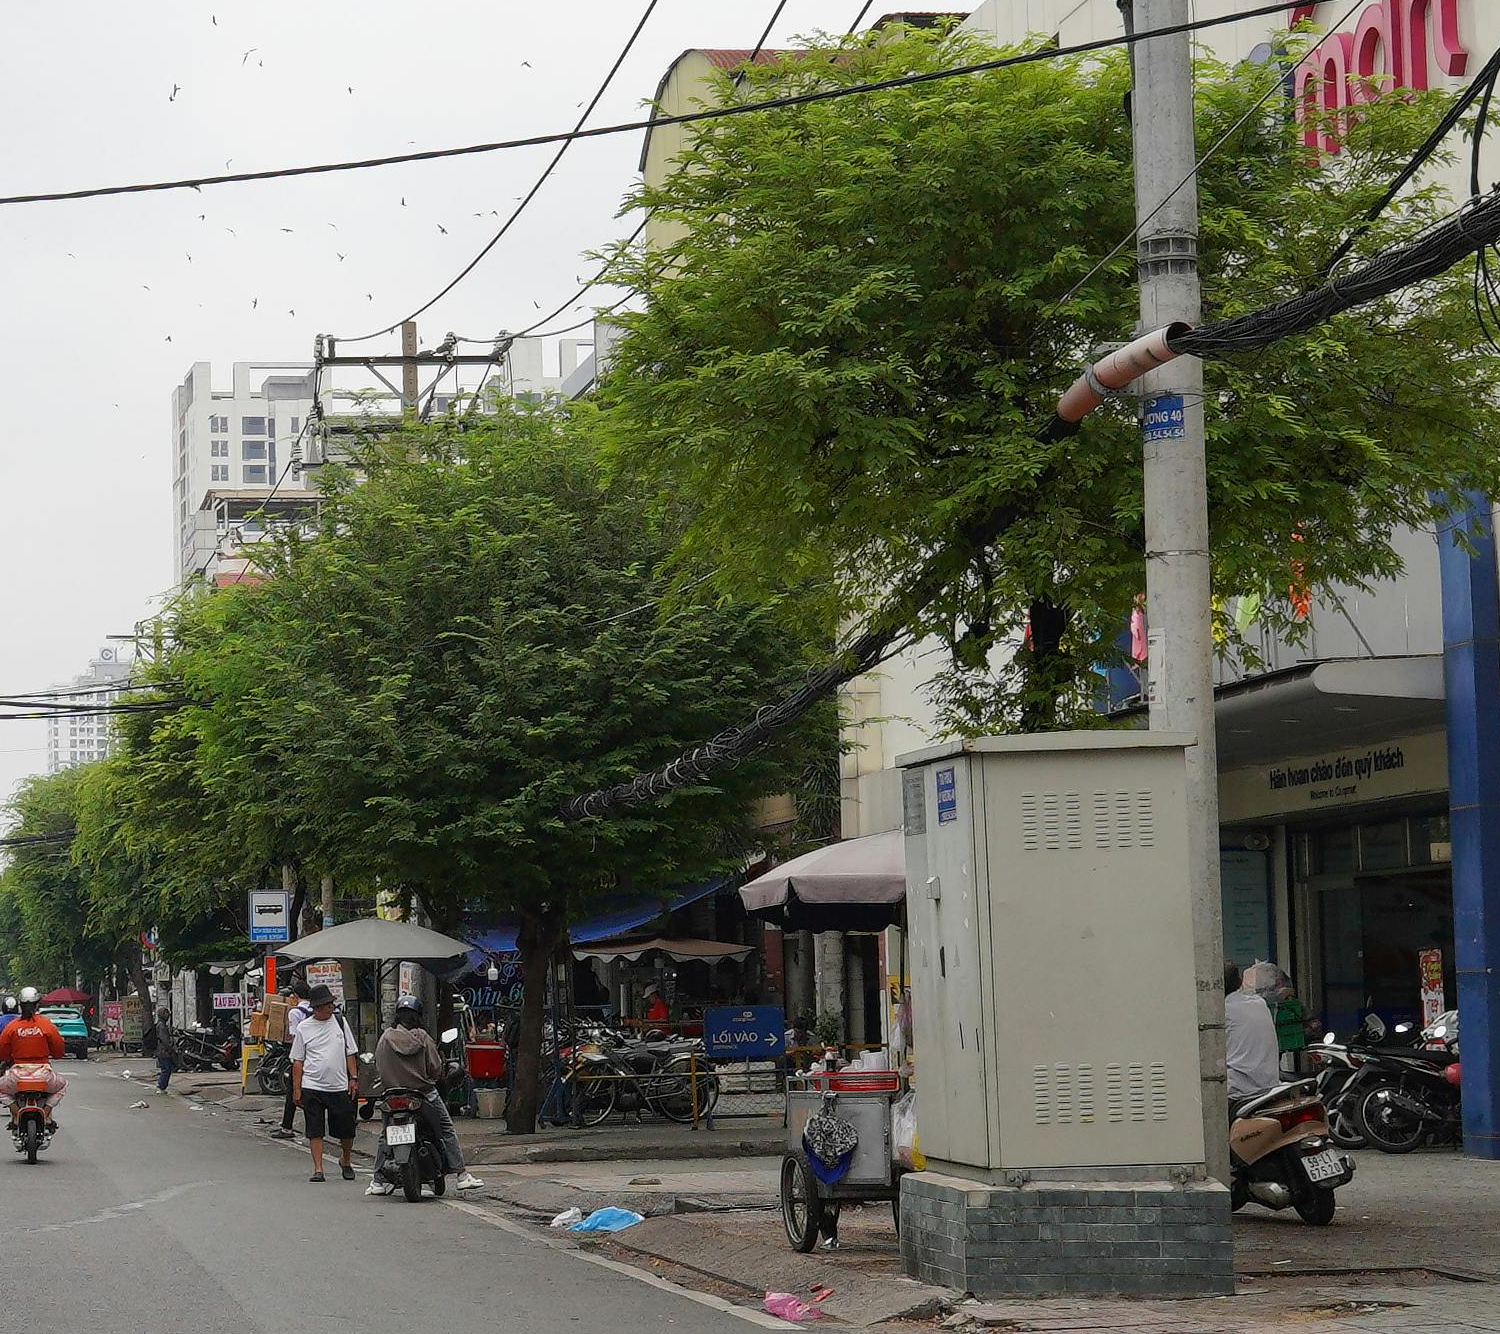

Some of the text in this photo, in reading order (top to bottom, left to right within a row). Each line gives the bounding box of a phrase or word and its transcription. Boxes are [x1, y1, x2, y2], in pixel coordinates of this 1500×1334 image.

[1335, 756, 1353, 779] đón
[1355, 752, 1372, 780] quý
[1374, 747, 1404, 772] khách
[712, 1029, 759, 1044] LỐI VÀO
